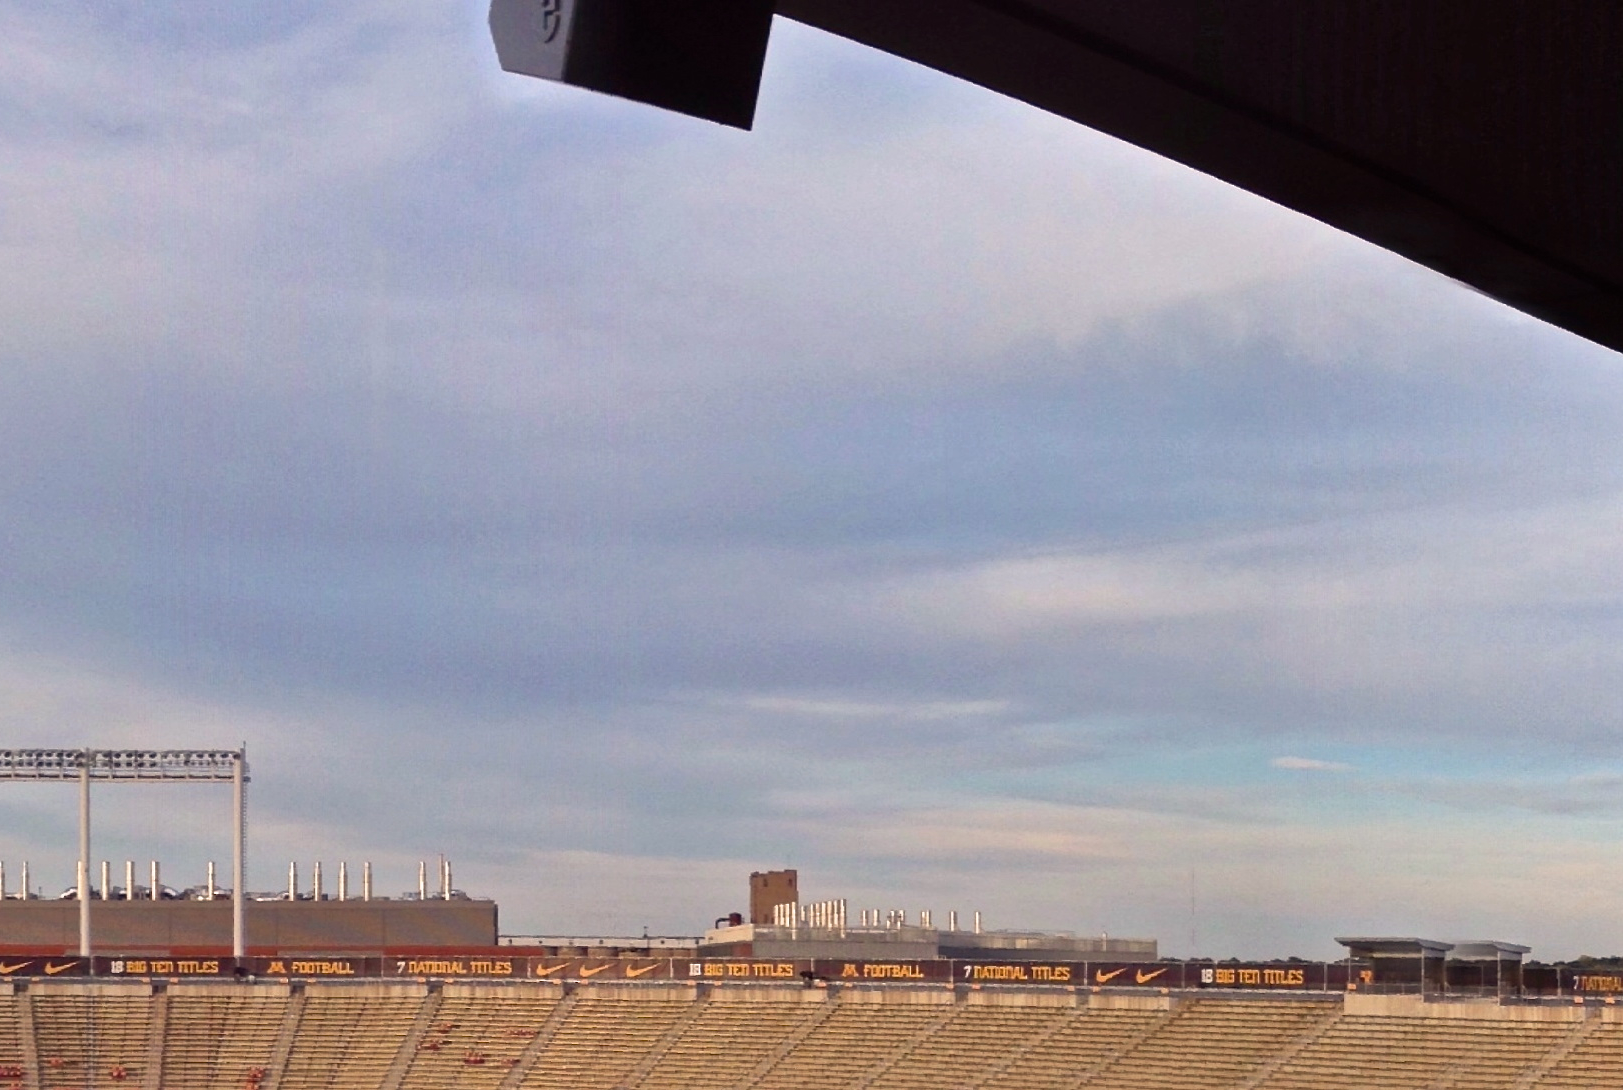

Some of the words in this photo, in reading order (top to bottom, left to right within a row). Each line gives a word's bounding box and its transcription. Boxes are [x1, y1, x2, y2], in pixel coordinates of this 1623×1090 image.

[127, 961, 147, 974] BIG
[178, 961, 219, 974] TITLES
[292, 962, 354, 974] FOOTBALL
[471, 962, 512, 974] TITLES
[705, 964, 724, 976] BIG
[753, 964, 793, 976] TITLES
[864, 964, 924, 977] FOOTBALL
[1031, 966, 1071, 980] TITLES
[1216, 969, 1234, 984] BIG
[1264, 969, 1303, 984] TITLES
